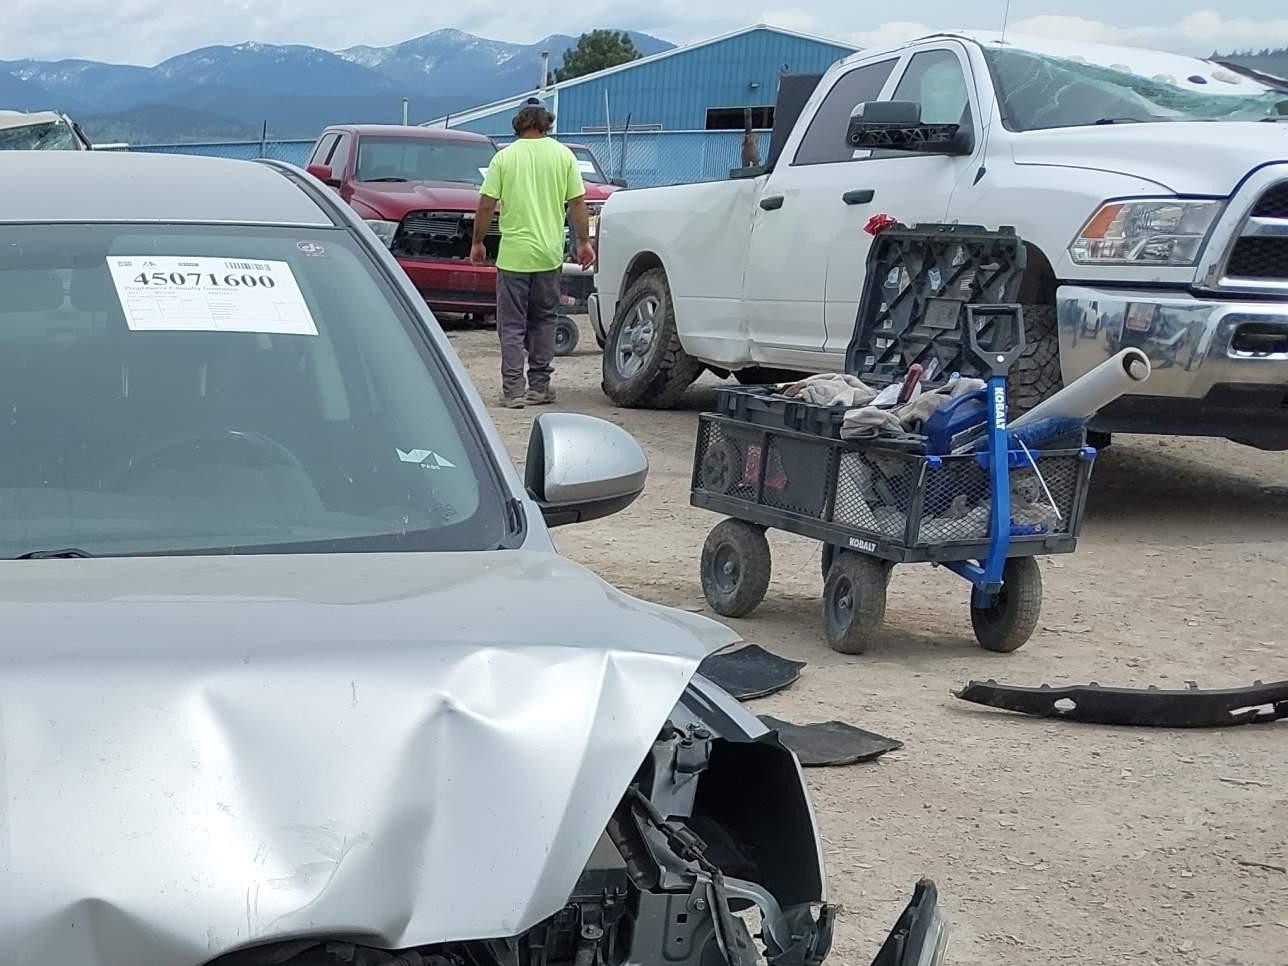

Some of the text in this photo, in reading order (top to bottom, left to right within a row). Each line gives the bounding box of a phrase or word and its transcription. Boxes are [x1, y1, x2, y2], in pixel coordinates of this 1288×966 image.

[134, 271, 275, 289] 45071600
[994, 386, 1006, 431] KOBALT
[848, 536, 877, 553] KOBALT
